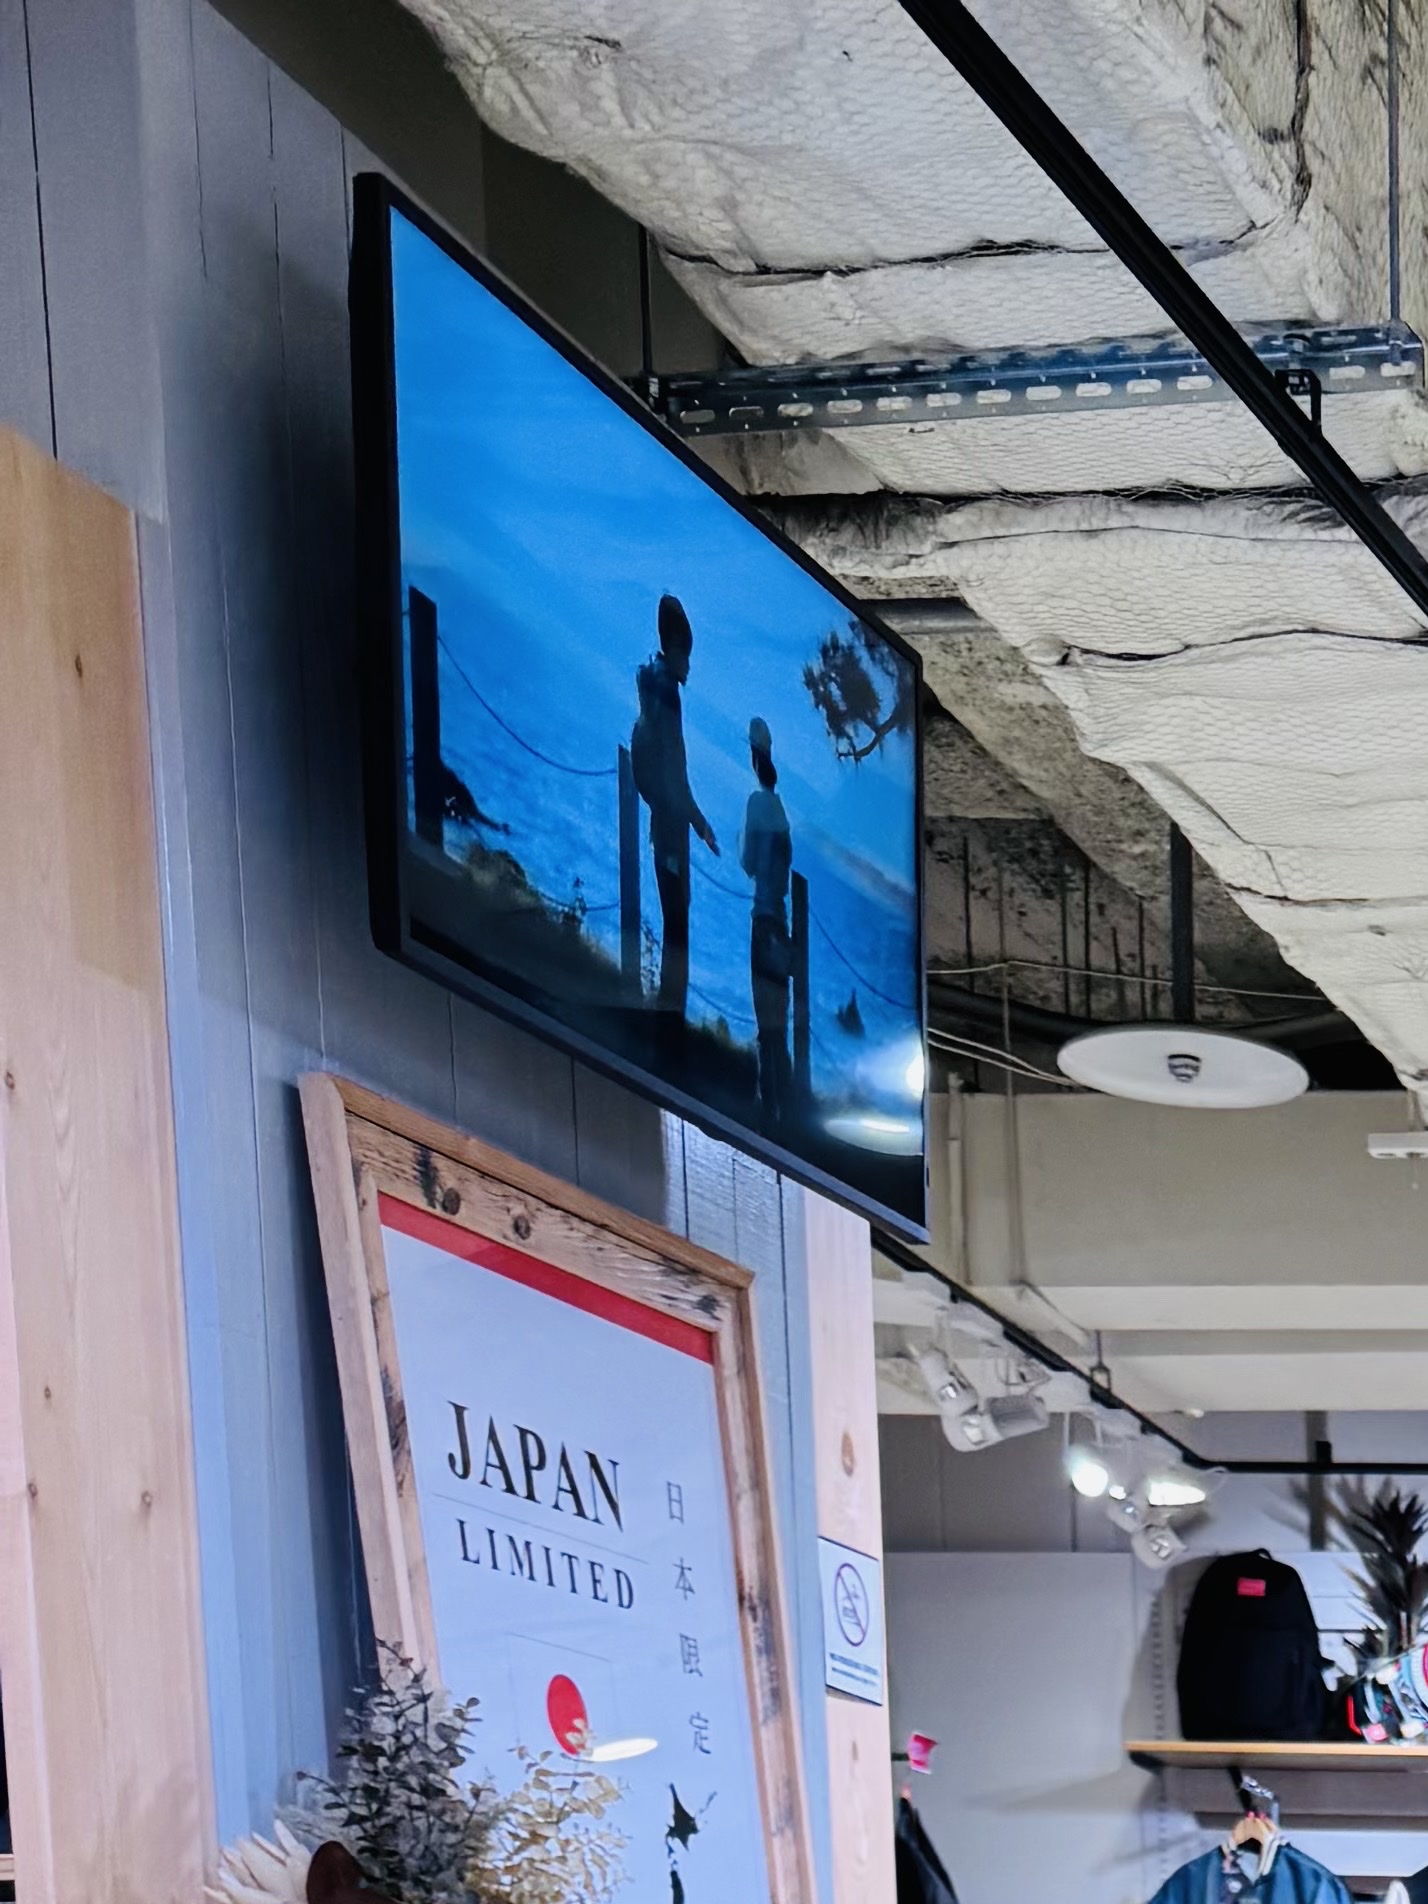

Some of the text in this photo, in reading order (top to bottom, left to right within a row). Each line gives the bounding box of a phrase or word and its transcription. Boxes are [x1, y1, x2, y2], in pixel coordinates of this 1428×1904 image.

[447, 1401, 624, 1532] JAPAN
[456, 1518, 634, 1610] LIMITED
[665, 1480, 712, 1755] 日本限定
